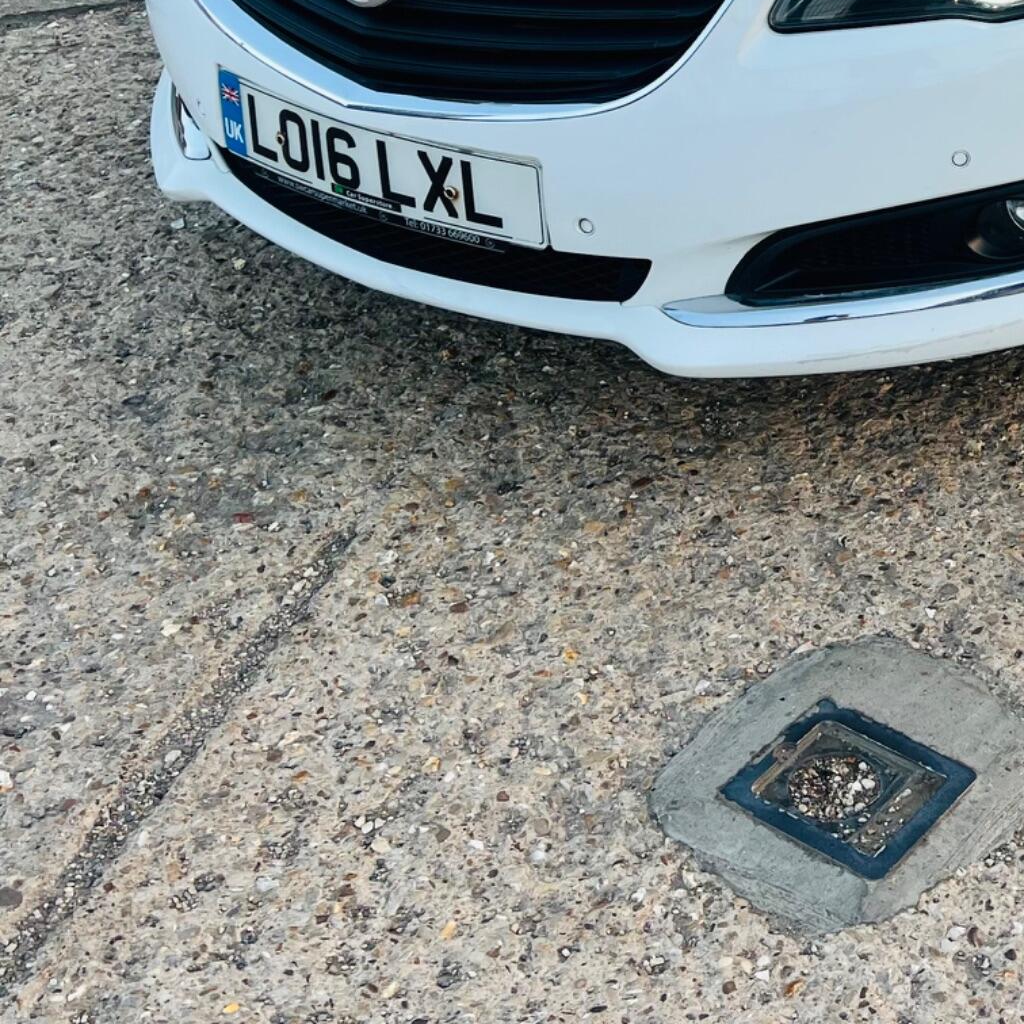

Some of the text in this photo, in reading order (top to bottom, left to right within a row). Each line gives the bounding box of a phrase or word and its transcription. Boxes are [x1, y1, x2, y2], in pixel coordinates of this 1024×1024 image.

[224, 117, 244, 143] UK
[247, 93, 503, 229] LO16 LXL
[346, 190, 360, 199] Car
[404, 217, 418, 227] Tel:
[420, 221, 447, 237] 01733
